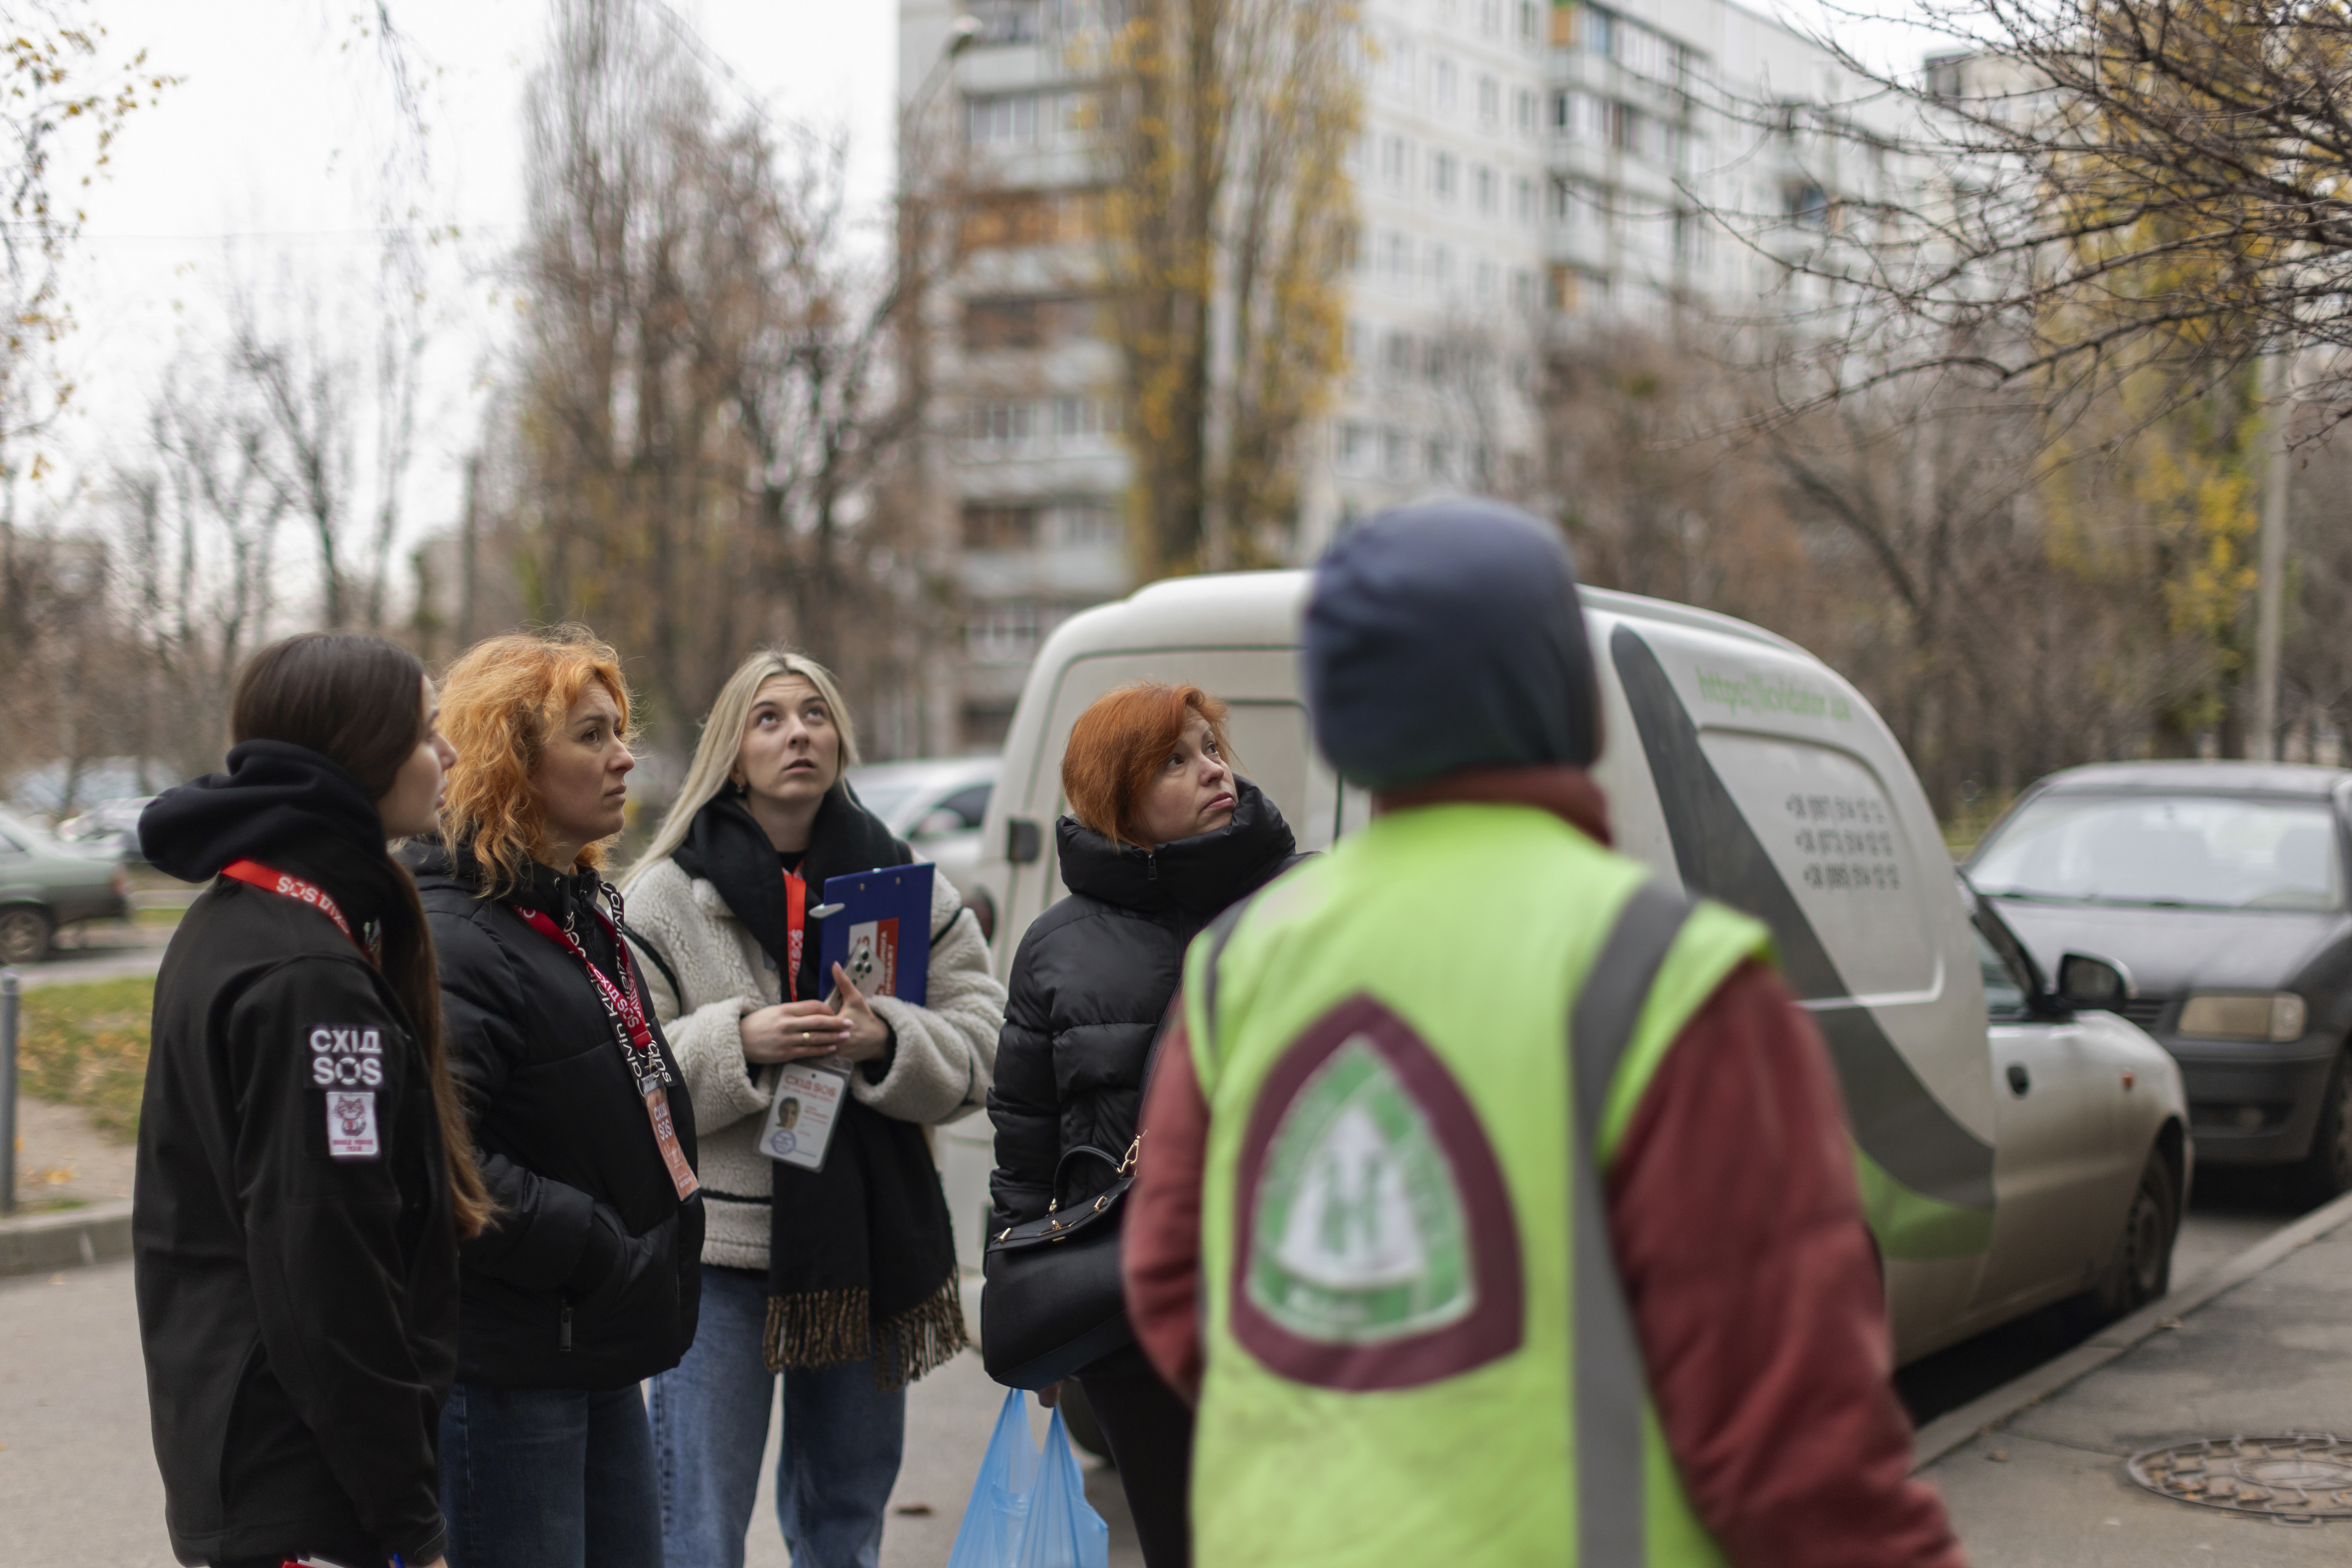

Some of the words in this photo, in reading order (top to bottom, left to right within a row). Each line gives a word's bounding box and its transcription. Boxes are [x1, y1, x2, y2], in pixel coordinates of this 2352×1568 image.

[276, 876, 319, 902] SOS
[593, 968, 620, 1003] СХІД
[617, 998, 640, 1029] SOS
[310, 1030, 383, 1054] СХІД
[313, 1056, 382, 1085] SOS
